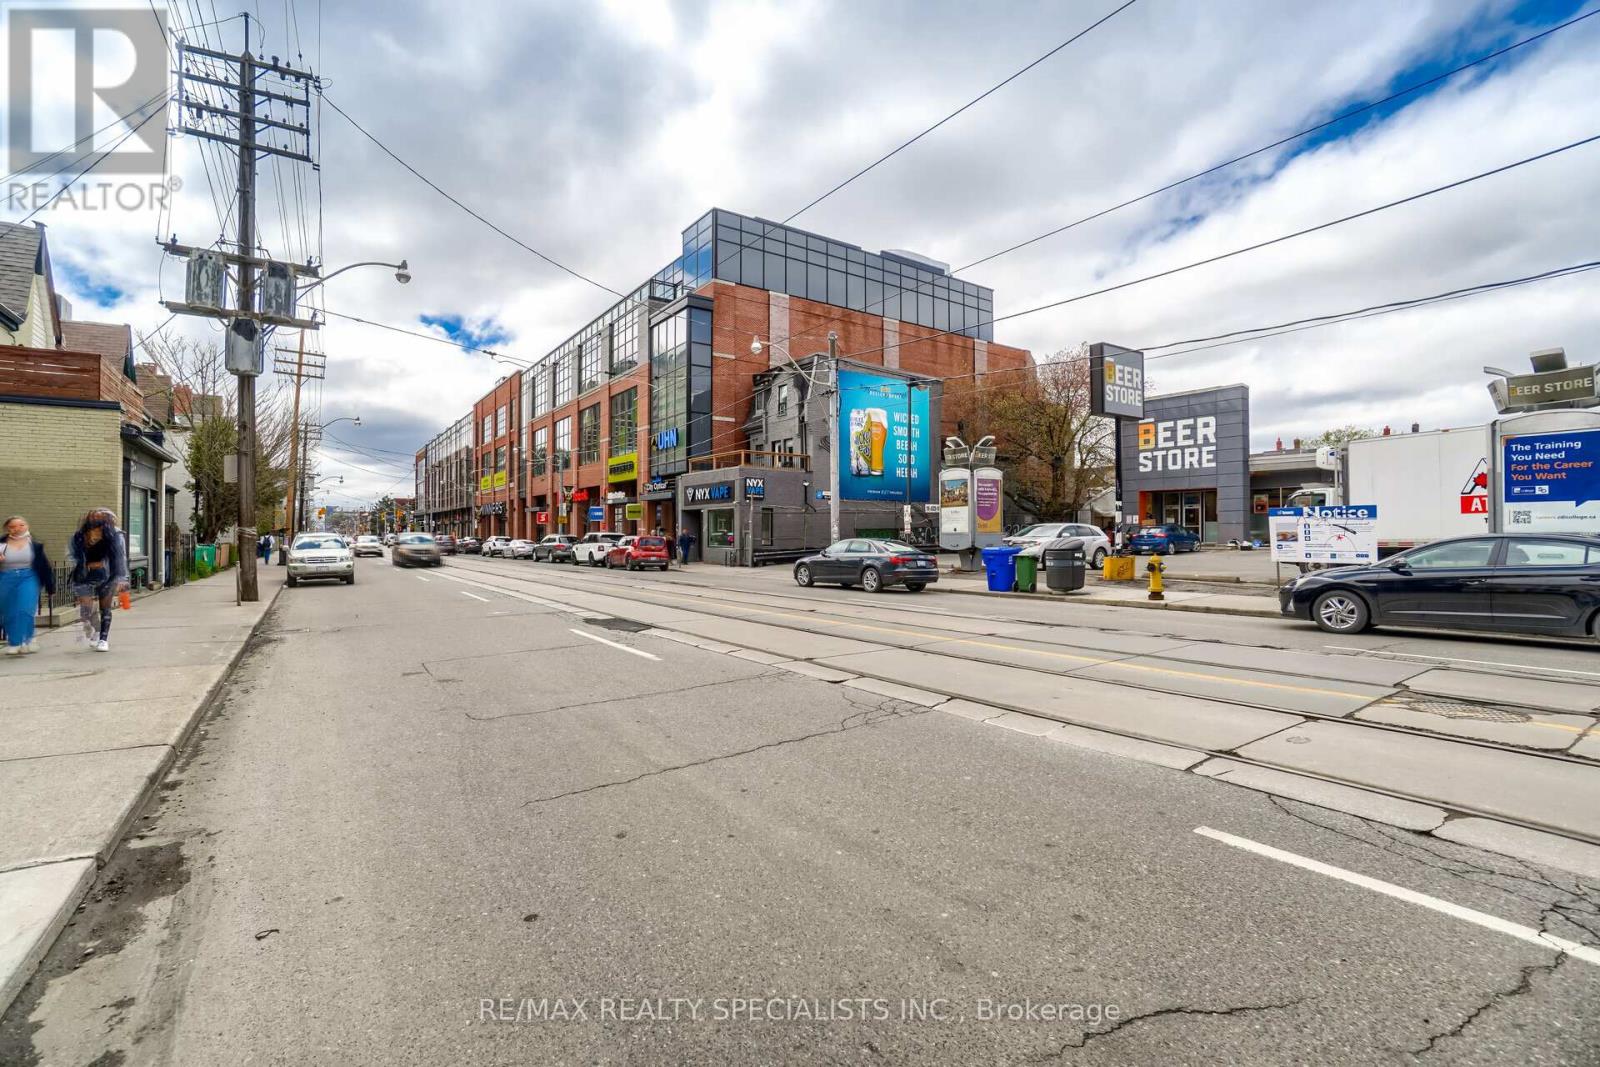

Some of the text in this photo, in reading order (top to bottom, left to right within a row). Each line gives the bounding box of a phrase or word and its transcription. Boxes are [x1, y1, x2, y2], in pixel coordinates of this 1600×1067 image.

[1104, 357, 1142, 389] BEER
[1508, 377, 1593, 397] BEER STORE
[1105, 384, 1142, 407] STORE
[893, 411, 920, 424] WICED
[657, 427, 678, 450] UHN
[893, 426, 920, 438] SMOTH
[1137, 416, 1217, 451] BEER
[1510, 440, 1582, 452] The Training
[898, 453, 916, 465] SOD
[1138, 446, 1217, 473] STORE
[1510, 450, 1566, 462] You Need
[1510, 460, 1594, 472] For the Career
[1510, 471, 1567, 481] You Want
[745, 478, 764, 488] NYX
[695, 486, 730, 501] NYX VAPE
[1302, 506, 1369, 519] Notice
